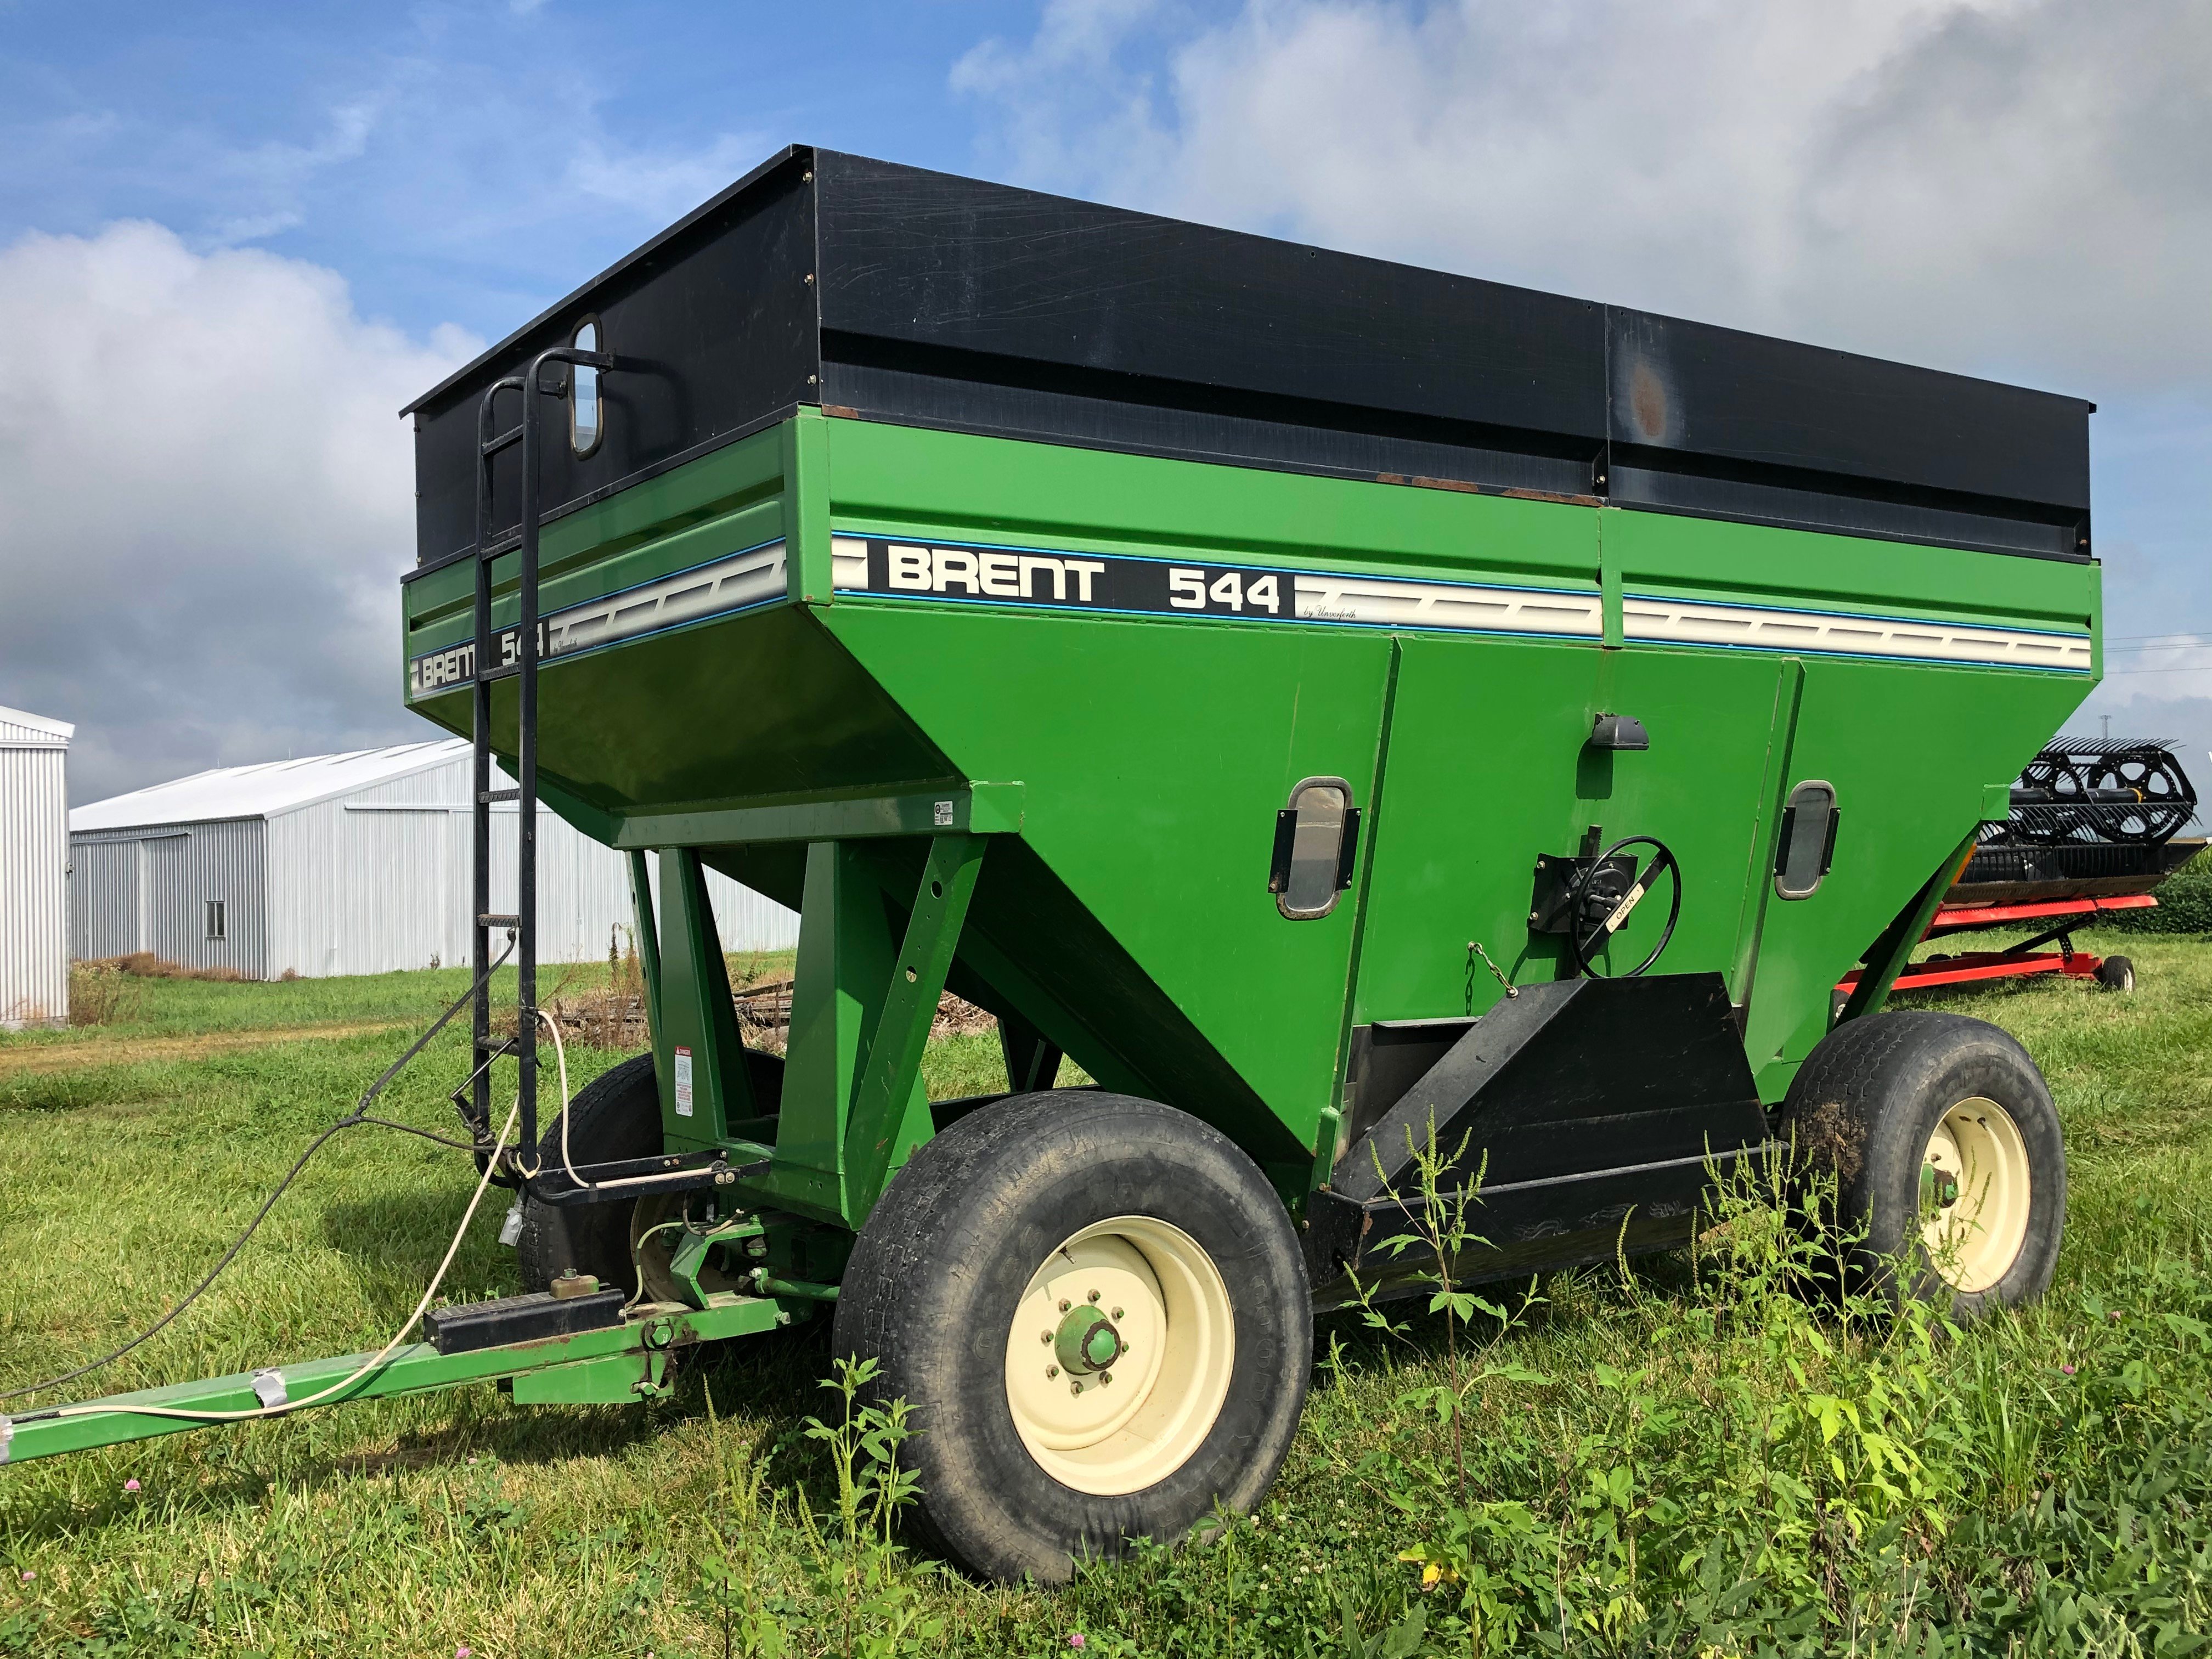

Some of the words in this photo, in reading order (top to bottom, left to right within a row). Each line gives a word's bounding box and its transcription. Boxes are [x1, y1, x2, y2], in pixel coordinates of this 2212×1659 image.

[888, 545, 1105, 602] BRENT
[1169, 568, 1279, 614] 544
[1304, 606, 1313, 619] by
[1616, 896, 1635, 919] OPEN
